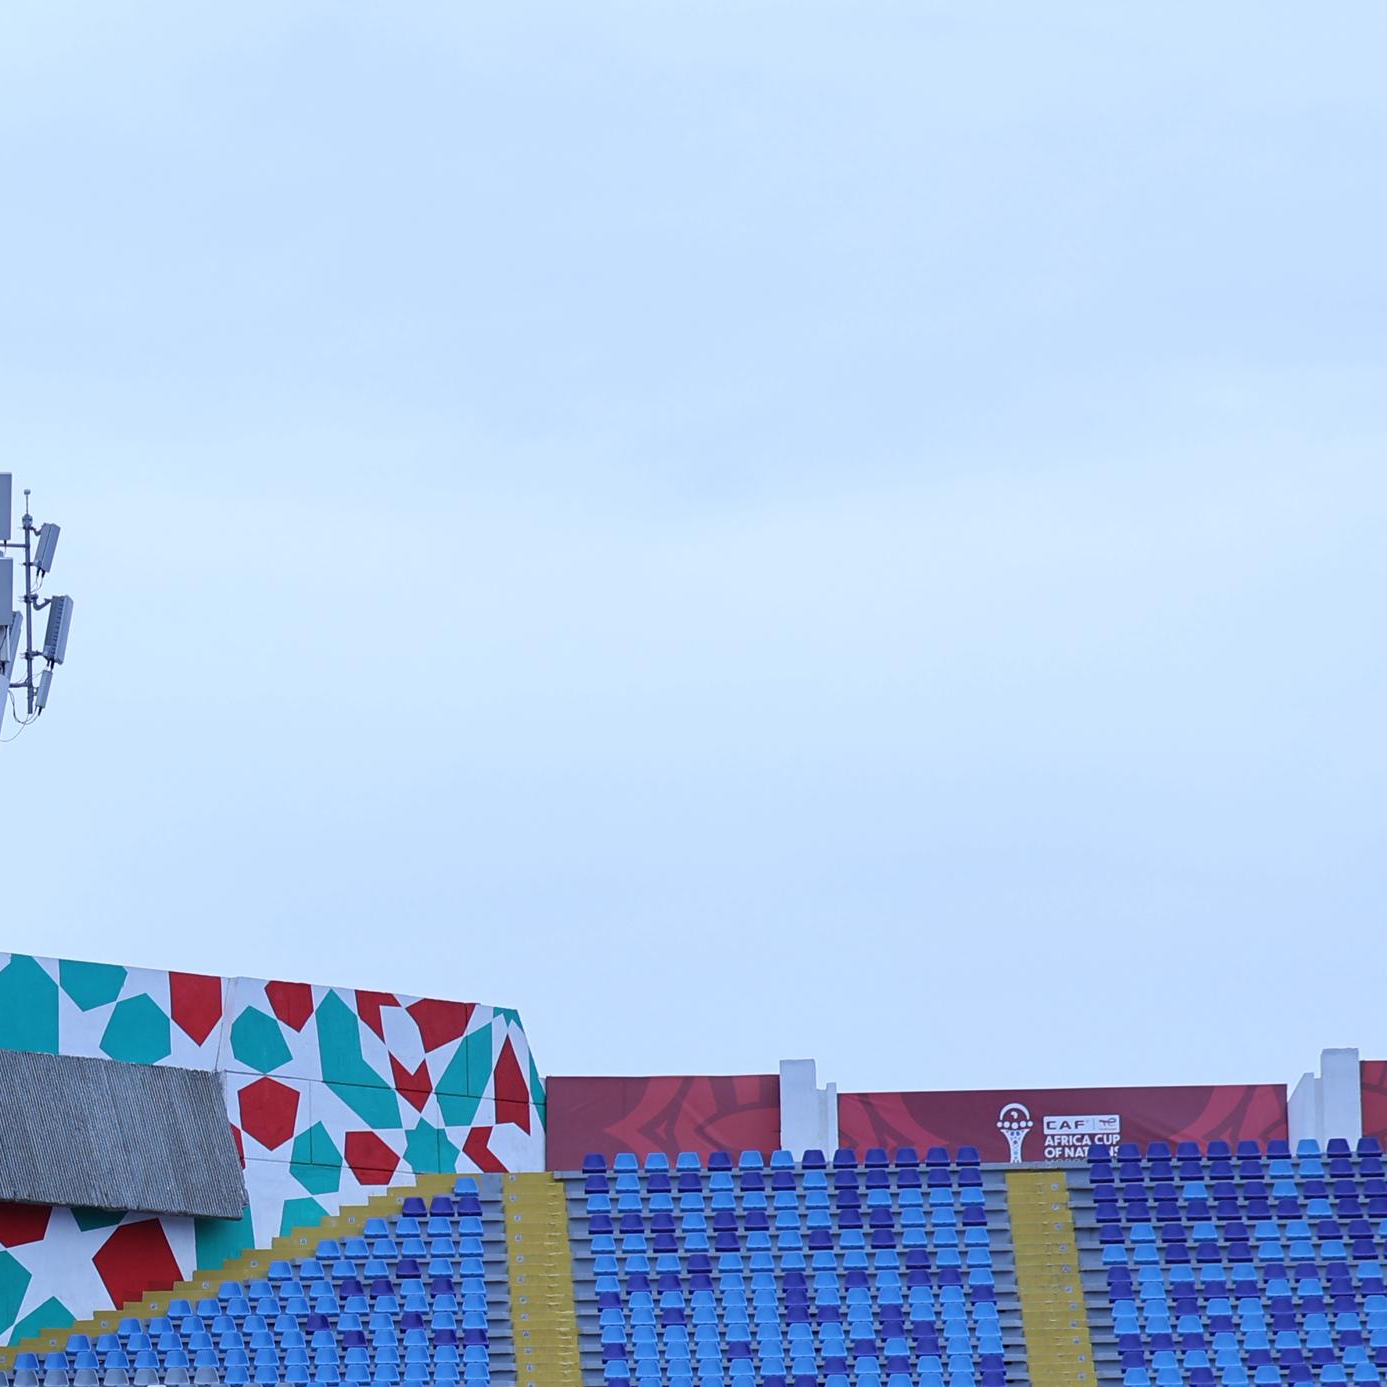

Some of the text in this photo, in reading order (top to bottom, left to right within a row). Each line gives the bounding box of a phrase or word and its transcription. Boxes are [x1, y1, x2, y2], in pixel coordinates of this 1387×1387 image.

[1047, 1120, 1085, 1131] CAF
[1044, 1134, 1121, 1146] AFRICA CUP
[1044, 1147, 1063, 1158] OF
